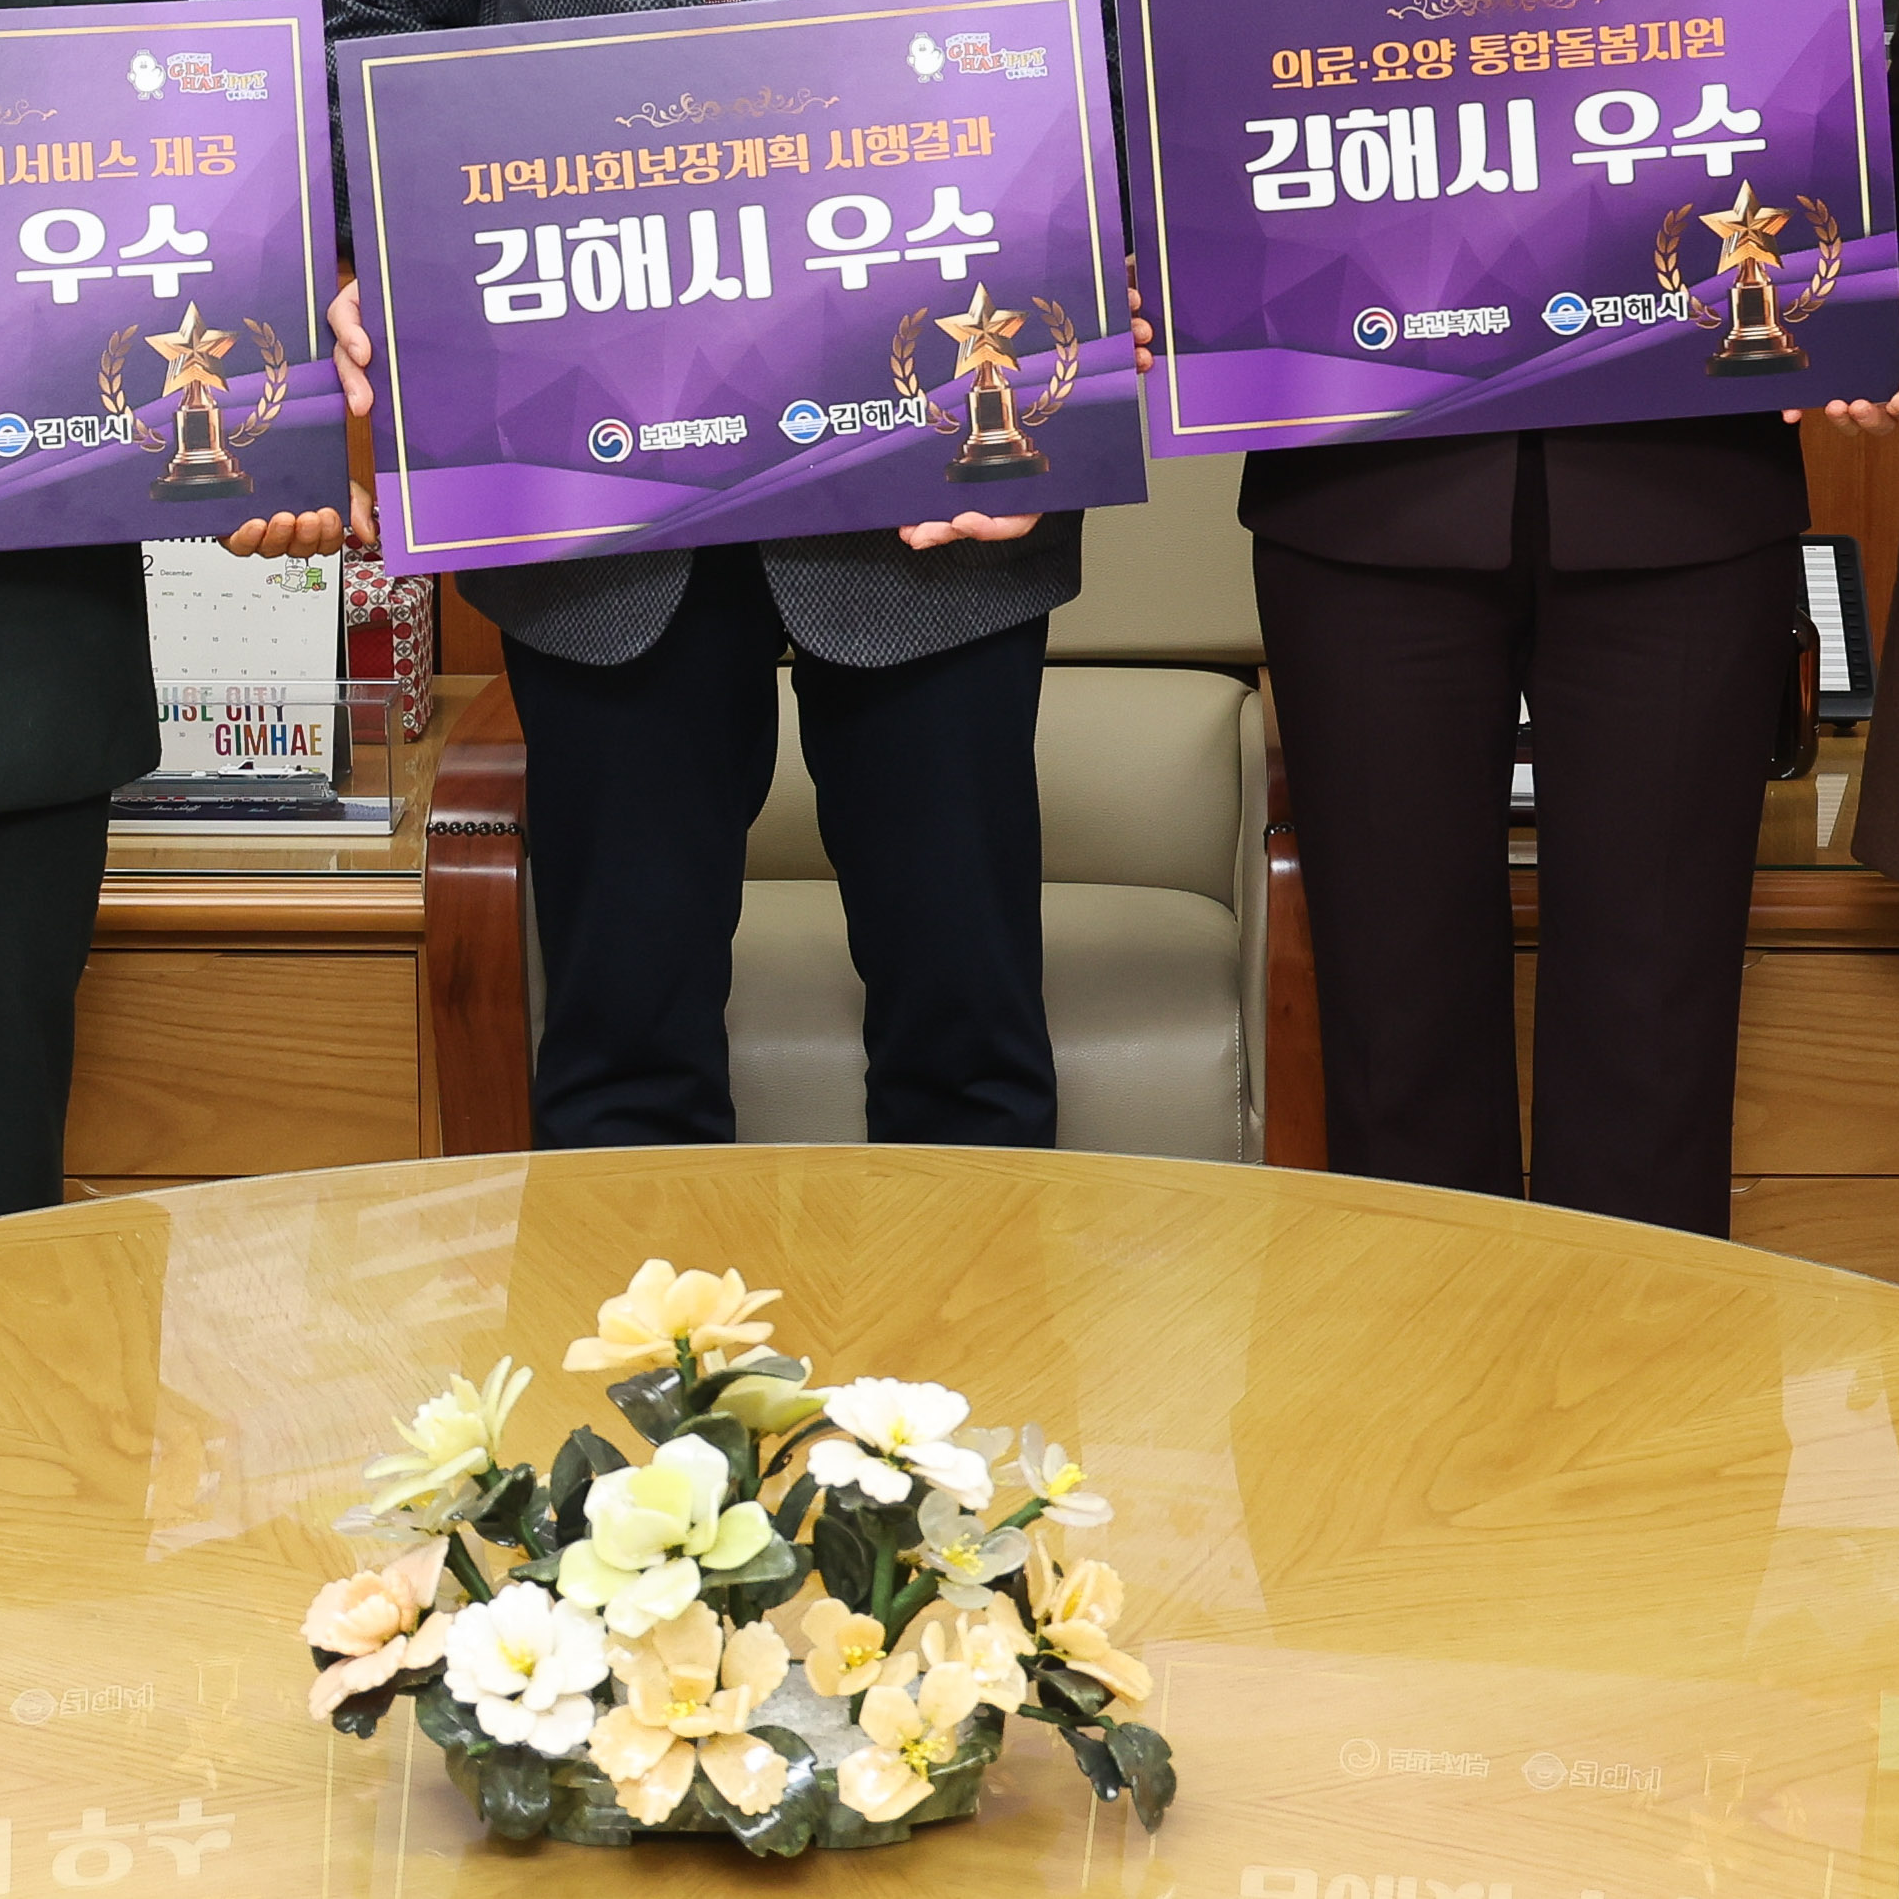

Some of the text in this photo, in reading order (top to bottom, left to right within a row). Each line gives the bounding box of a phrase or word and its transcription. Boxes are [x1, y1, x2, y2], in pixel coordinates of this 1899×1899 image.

[1270, 15, 1727, 91] 의료·요양 통합돌봄지원
[149, 134, 239, 178] 제공
[459, 114, 997, 206] 지역사회보장계획 시행결과
[1243, 82, 1768, 213] 김해시 우수
[14, 202, 215, 306] 우수
[473, 184, 1001, 325] 김해시 우수
[1403, 305, 1511, 341] 보건복지부
[1592, 291, 1689, 325] 김해시
[34, 412, 134, 449] 김해시
[639, 413, 747, 451] 보건복지부
[828, 397, 927, 436] 김해시
[159, 568, 194, 578] December
[158, 686, 287, 723] UISE CITY
[214, 723, 323, 757] GIMHAE
